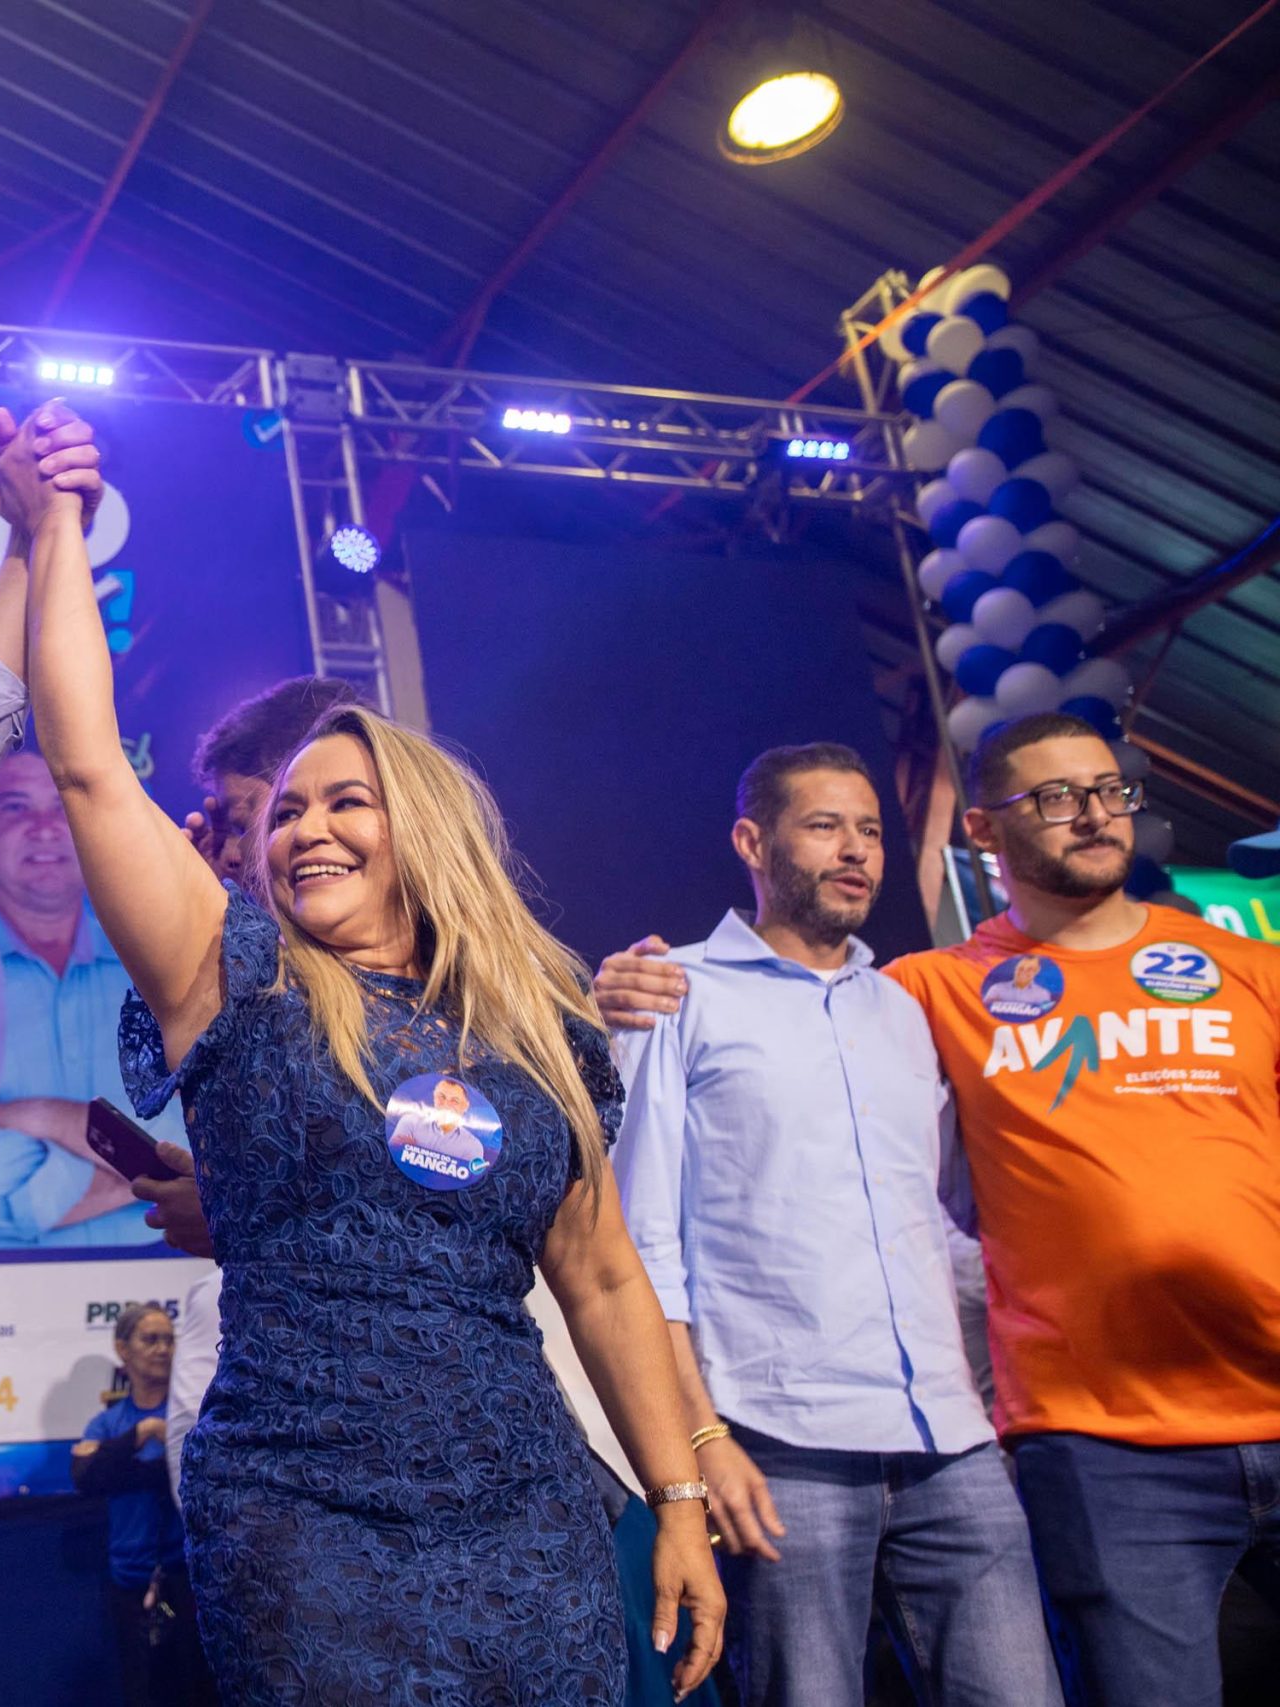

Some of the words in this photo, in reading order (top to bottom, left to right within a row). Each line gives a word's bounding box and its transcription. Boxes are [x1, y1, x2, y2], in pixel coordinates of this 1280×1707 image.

[1143, 951, 1207, 980] 22
[983, 1007, 1236, 1113] AVANTE
[1125, 1068, 1187, 1083] ELEIÇÕES
[401, 1149, 470, 1180] MANGÃO
